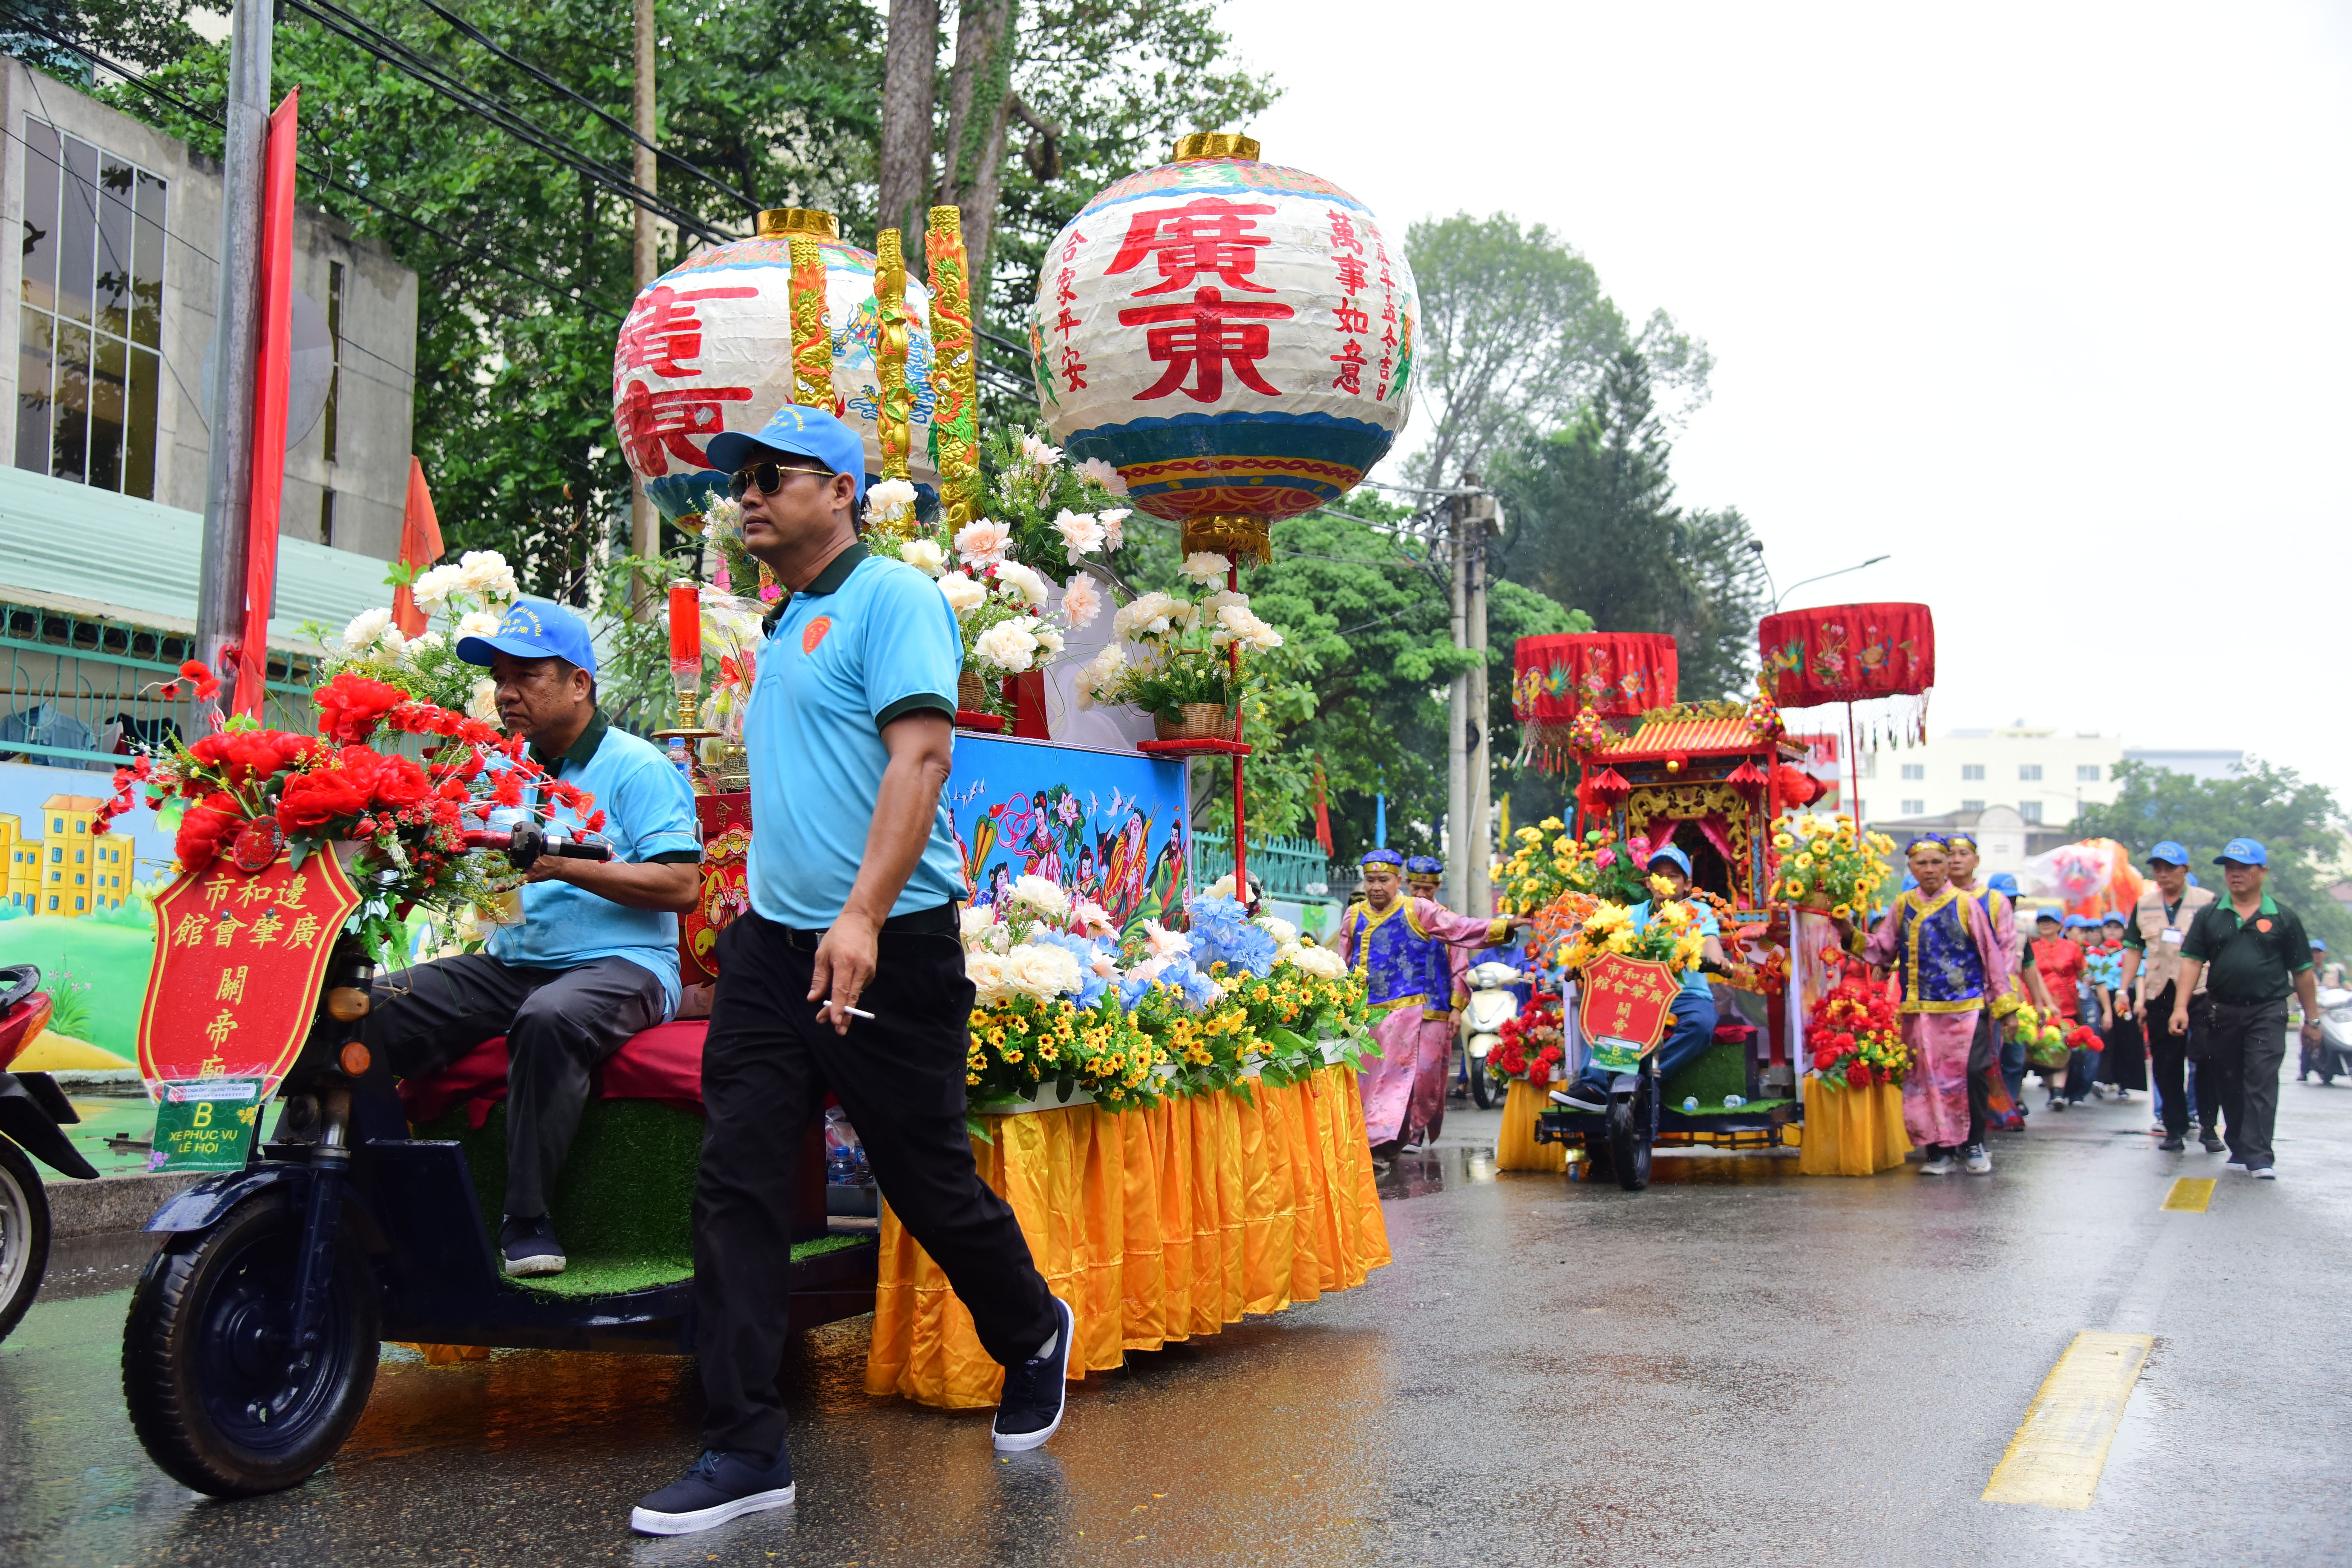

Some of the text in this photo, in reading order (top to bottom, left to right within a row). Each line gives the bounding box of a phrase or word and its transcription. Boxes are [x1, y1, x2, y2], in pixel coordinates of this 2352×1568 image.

[1053, 229, 1088, 392] 合家平安
[1103, 197, 1295, 403] 廣東
[1326, 209, 1369, 395] 萬事如意
[527, 611, 539, 623] BIÊN
[534, 623, 543, 637] HÒA
[1612, 1002, 1631, 1038] 關帝
[1612, 1046, 1620, 1056] B
[193, 1102, 213, 1127] B
[169, 1130, 238, 1141] XE PHỤC VỤ
[179, 1141, 219, 1155] LỄ HỘI
